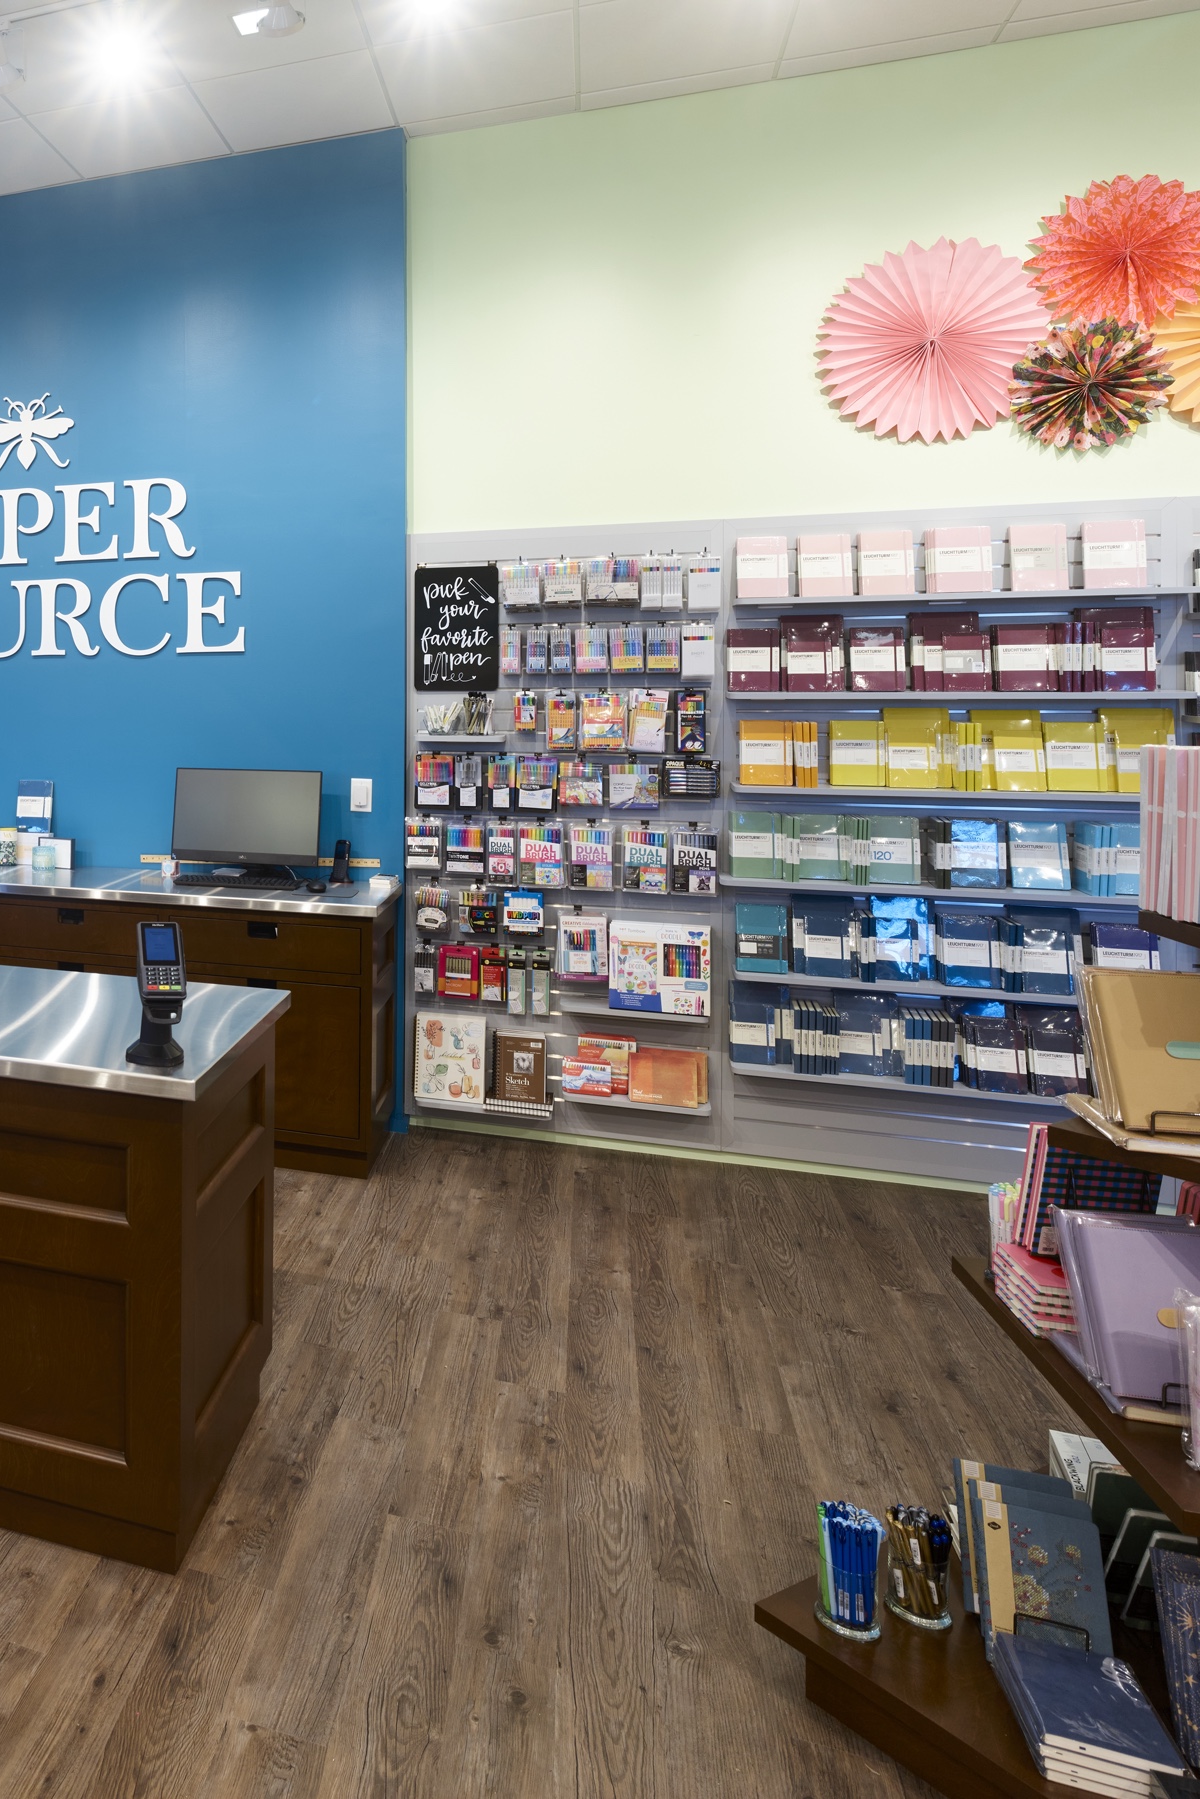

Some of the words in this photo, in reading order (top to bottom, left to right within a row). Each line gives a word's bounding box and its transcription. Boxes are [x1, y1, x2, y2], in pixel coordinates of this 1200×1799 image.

[423, 576, 470, 609] pick
[438, 600, 488, 630] your
[420, 626, 494, 653] favorite
[450, 652, 492, 670] pen
[525, 844, 556, 852] DUAL
[576, 846, 608, 854] DUAL
[630, 847, 662, 857] DUAL
[525, 851, 556, 860] BRUSH
[576, 853, 608, 862] BRUSH
[630, 856, 662, 864] BRUSH
[678, 850, 712, 860] DUAL
[678, 859, 712, 867] BRUSH
[660, 933, 682, 941] DOODLE
[505, 1076, 530, 1086] Sketch
[1063, 1458, 1086, 1492] BLACKWING
